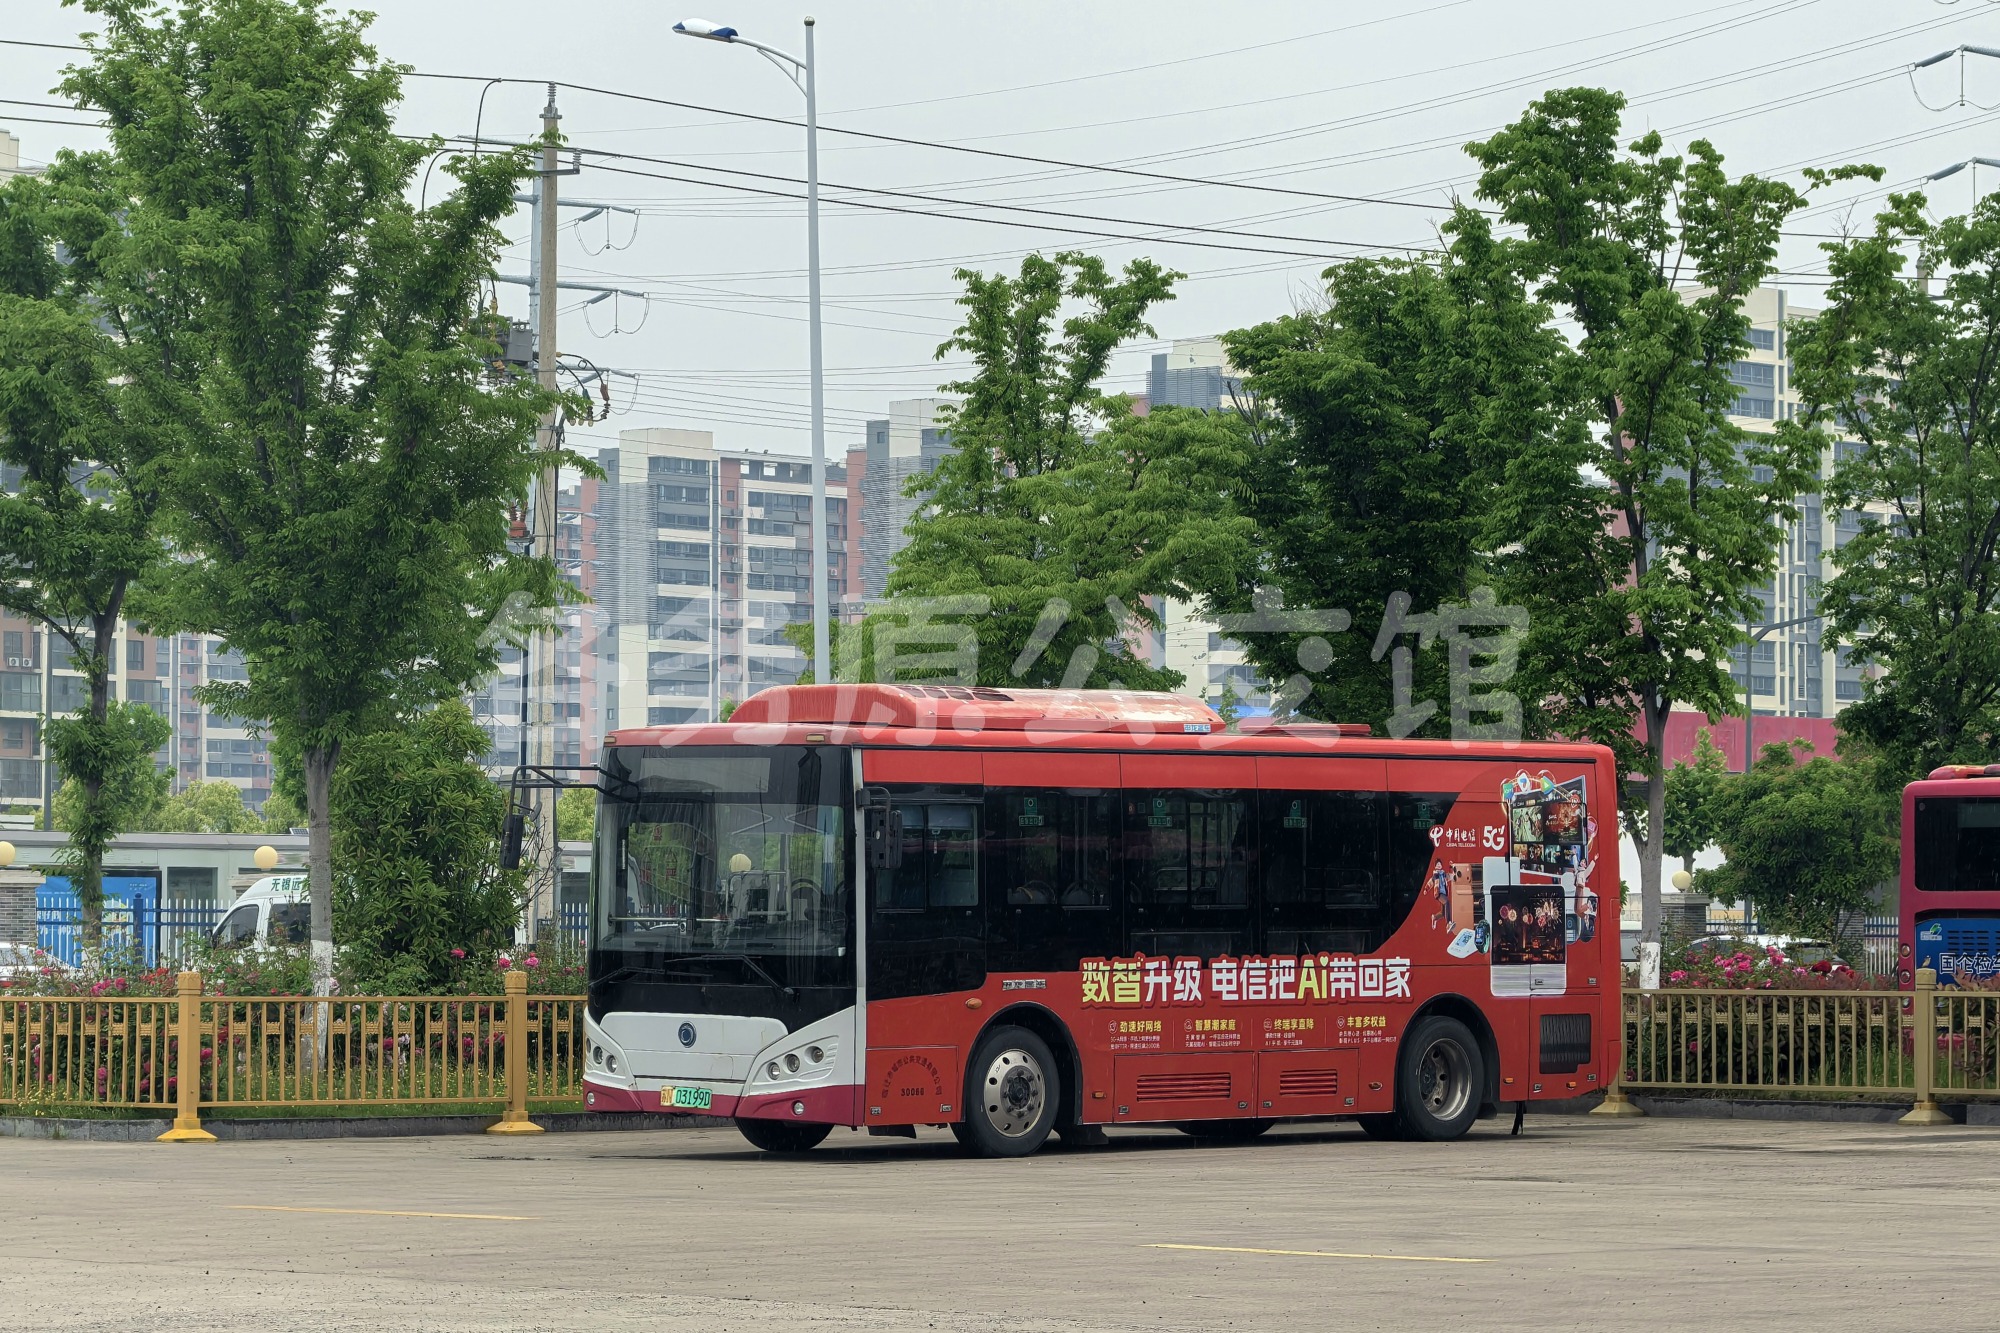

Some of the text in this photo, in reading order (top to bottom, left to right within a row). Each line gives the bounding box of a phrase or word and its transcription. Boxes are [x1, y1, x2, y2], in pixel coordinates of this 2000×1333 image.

[1446, 828, 1476, 842] 中国电信
[1082, 957, 1202, 1003] 数智升级
[1347, 1016, 1387, 1028] 丰富多权益
